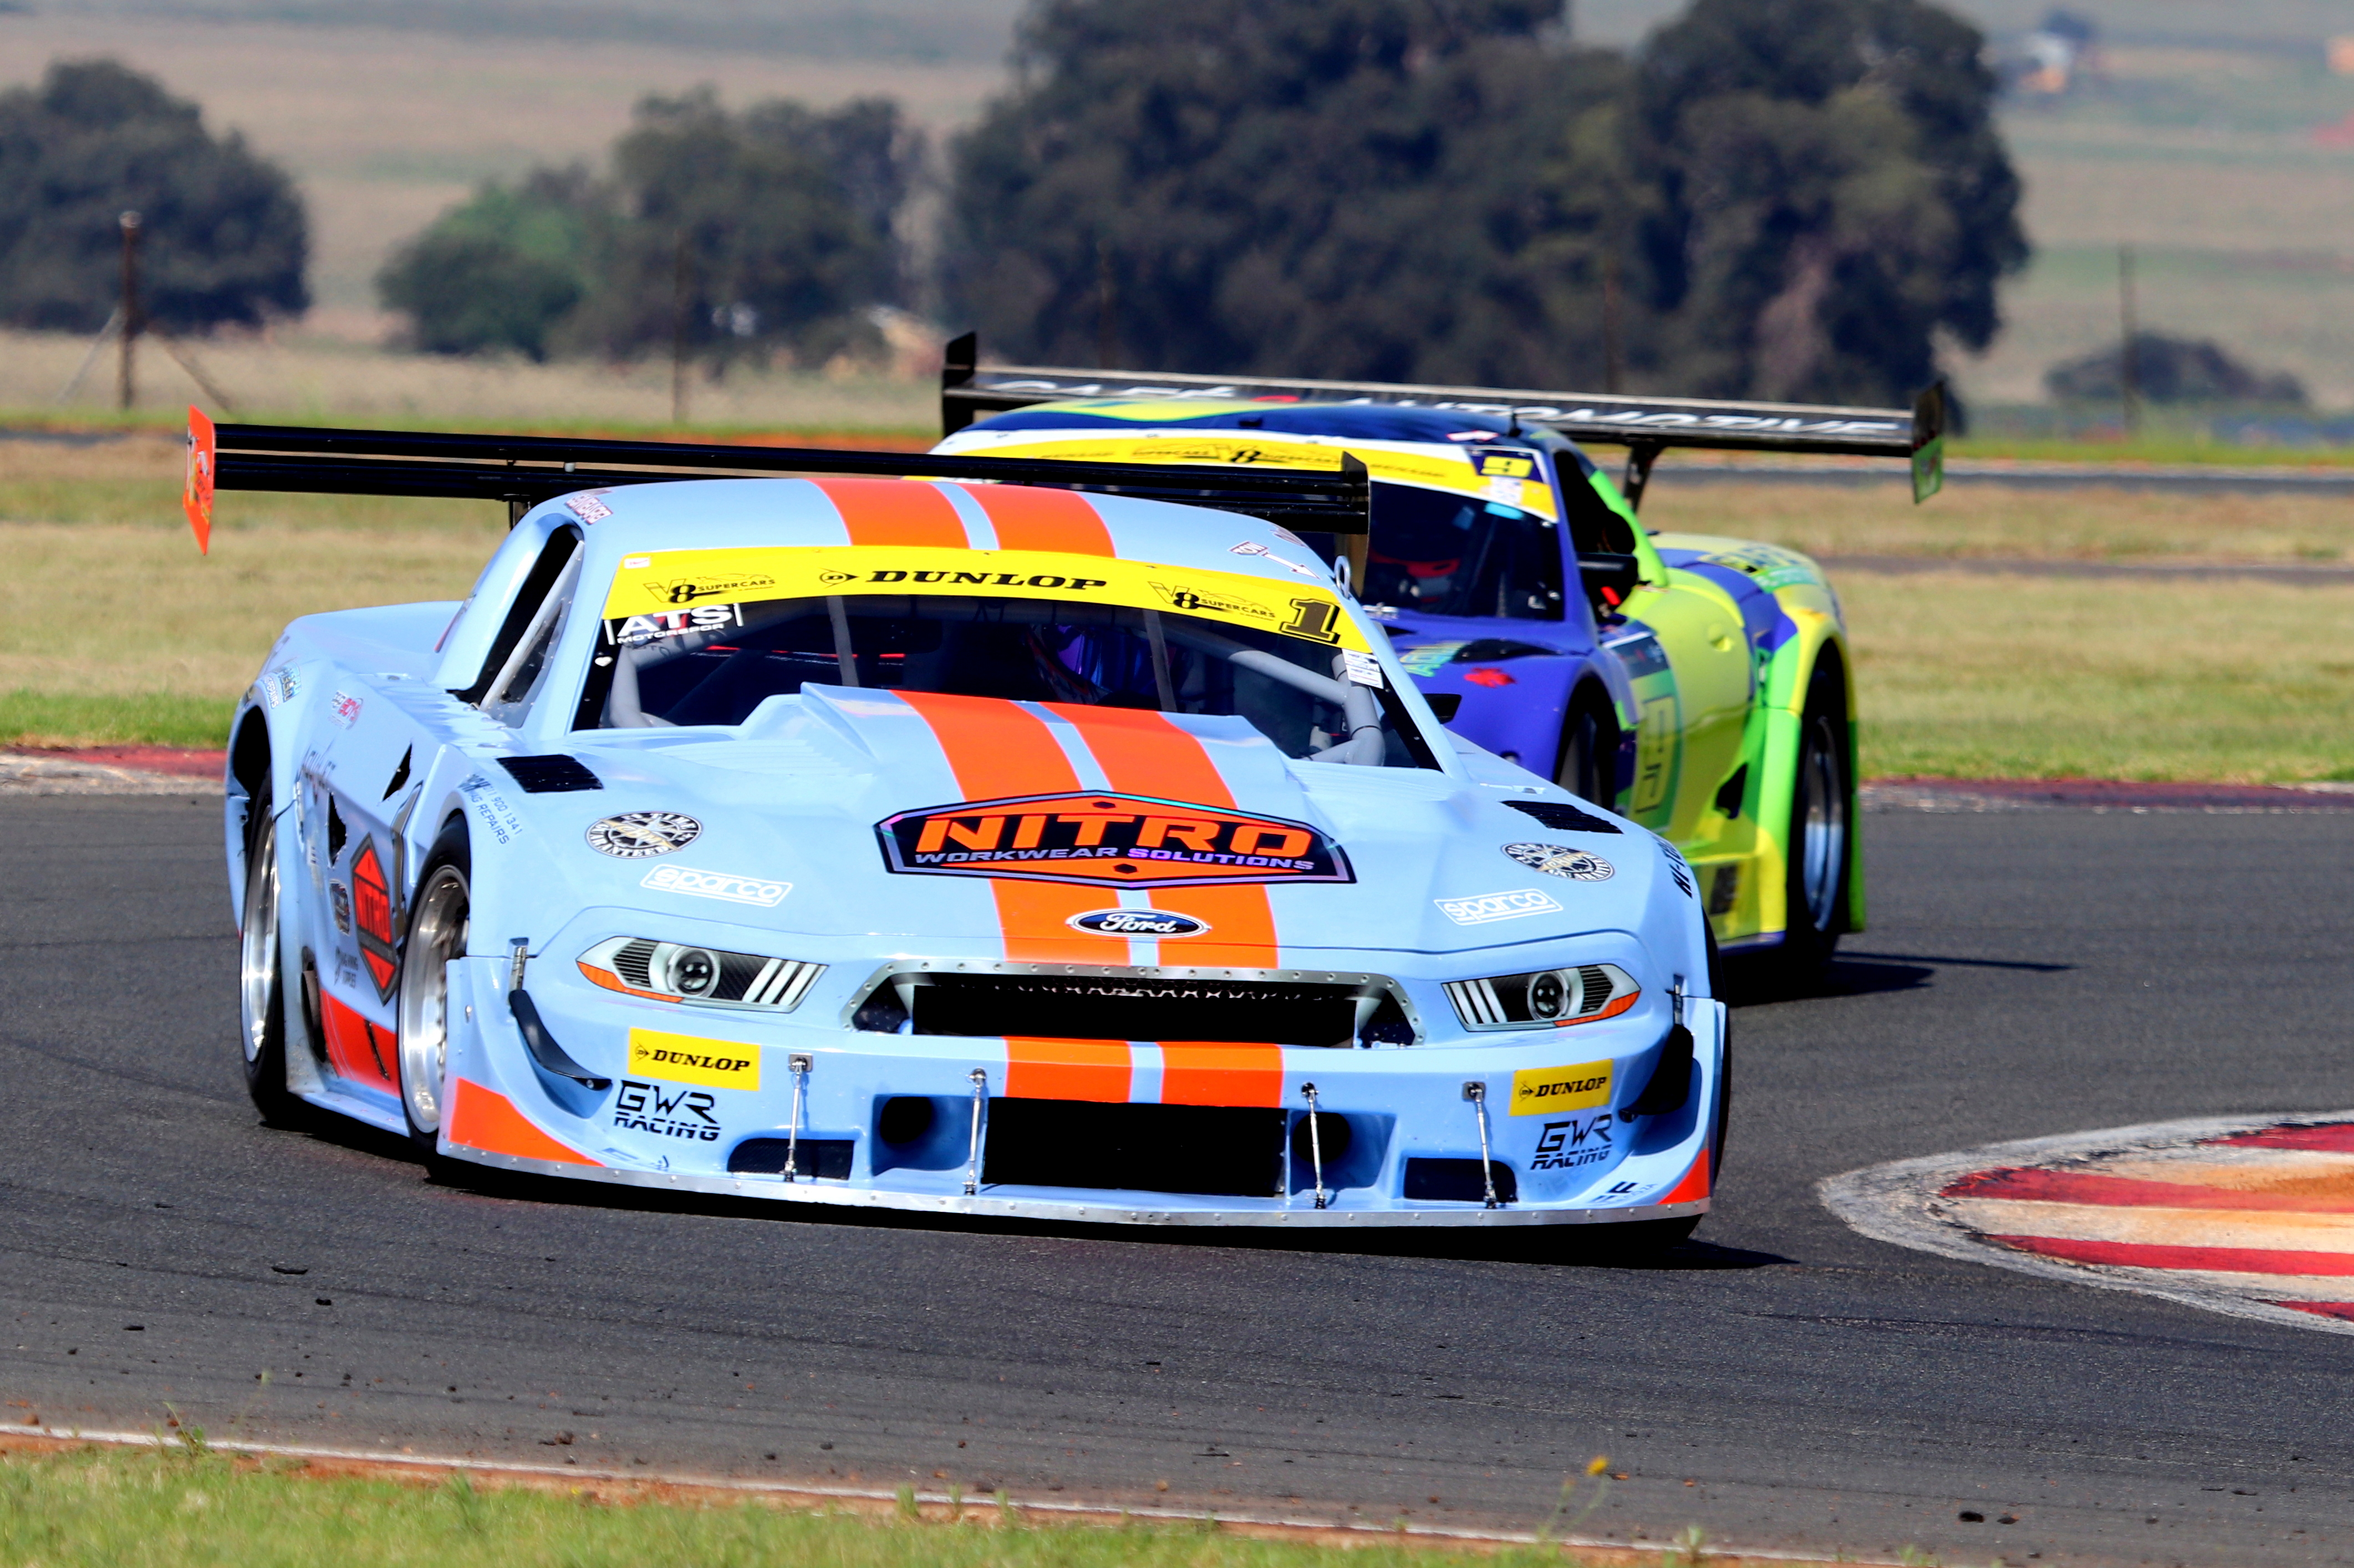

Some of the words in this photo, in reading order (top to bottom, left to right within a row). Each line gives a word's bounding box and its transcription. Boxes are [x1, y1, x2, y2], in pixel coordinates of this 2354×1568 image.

[698, 579, 776, 592] SUPERCARS
[865, 571, 1107, 590] DUNLOP
[617, 605, 733, 637] ATS
[1200, 598, 1276, 618] SUPERCARS
[1280, 598, 1341, 644] 1
[476, 803, 509, 844] REPAIRS
[503, 812, 522, 835] 1341
[915, 815, 1312, 857] NITRO
[915, 847, 1119, 864] WORKWEAR
[1127, 847, 1314, 871] SOLUTIONS
[653, 868, 783, 899] sparco
[1443, 892, 1547, 920] sparco
[1100, 911, 1178, 935] Ford
[652, 1050, 750, 1071] DUNLOP
[1535, 1077, 1607, 1097] DUNLOP
[615, 1080, 719, 1124] GWR
[614, 1111, 721, 1141] RACING
[1536, 1114, 1612, 1153] GWR
[1530, 1144, 1612, 1170] RACING
